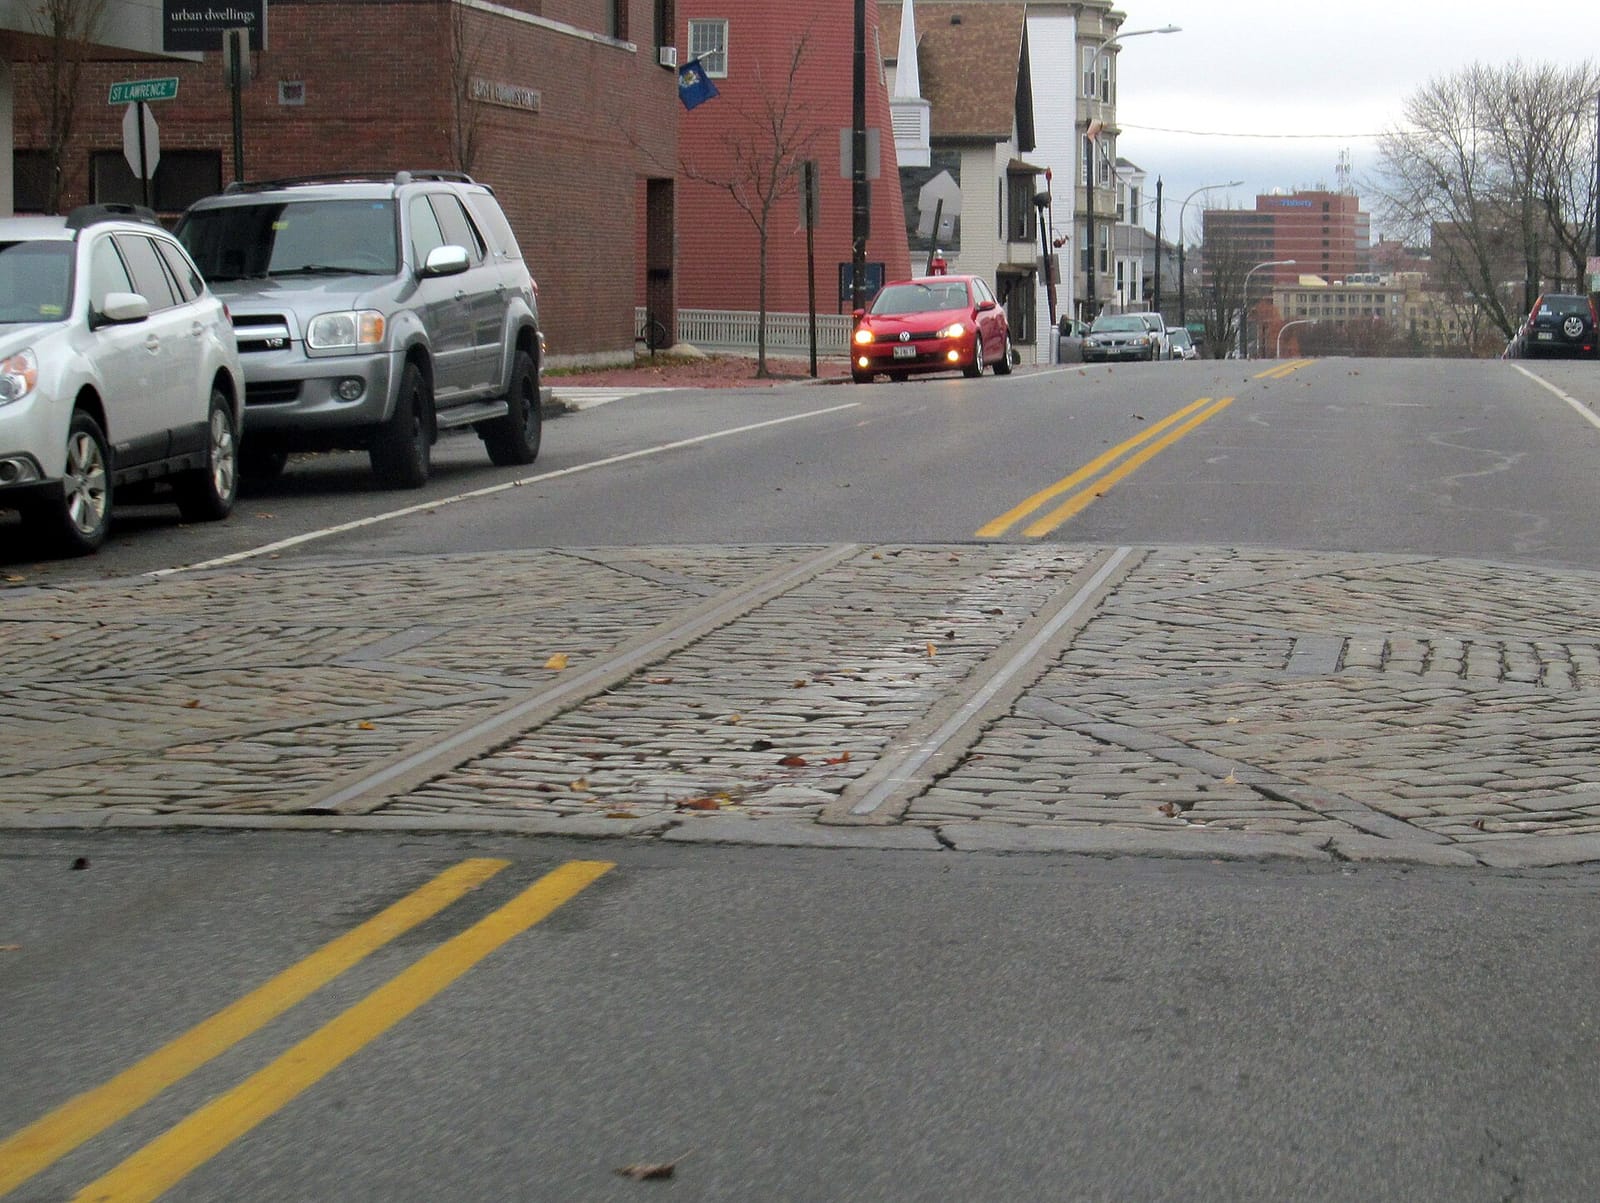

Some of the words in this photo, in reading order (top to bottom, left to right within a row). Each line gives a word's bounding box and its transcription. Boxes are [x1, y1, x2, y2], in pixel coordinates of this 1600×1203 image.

[171, 8, 203, 22] urban
[204, 8, 256, 24] dwellings
[111, 86, 122, 101] ST
[123, 82, 166, 99] LAWRENCE
